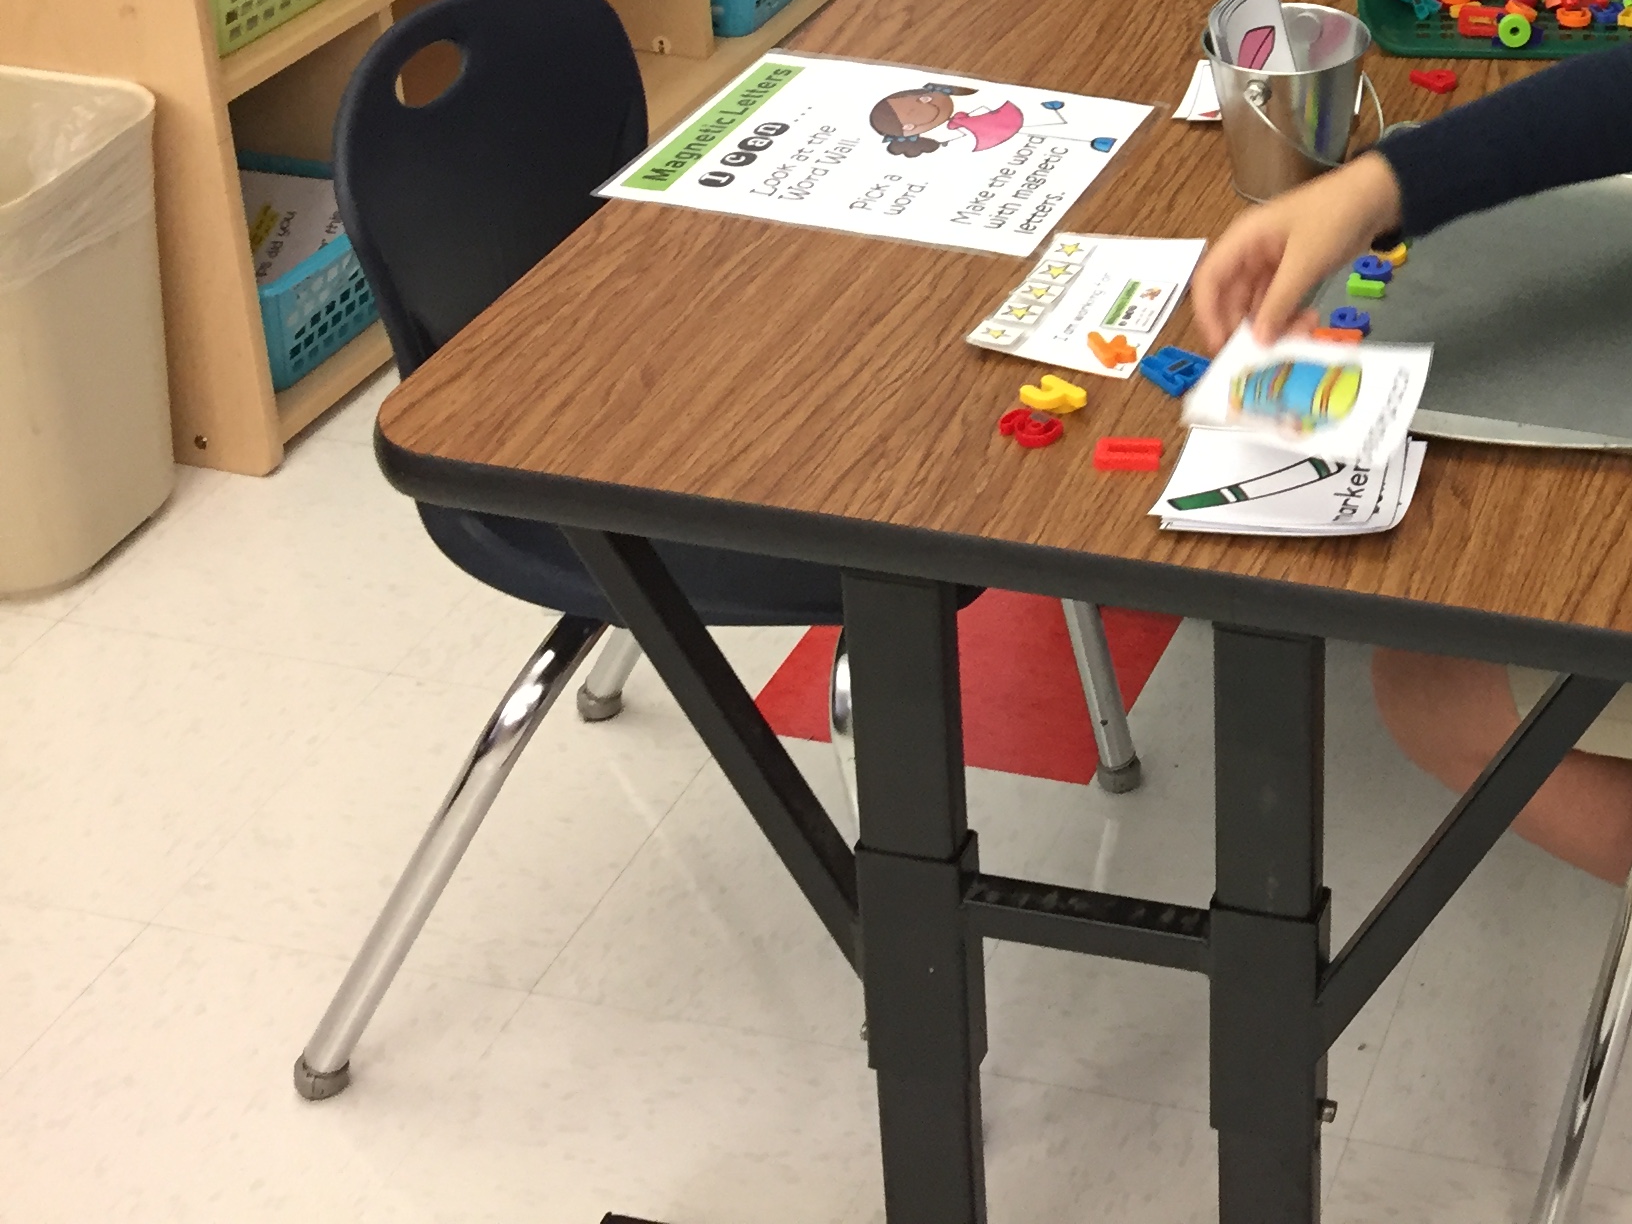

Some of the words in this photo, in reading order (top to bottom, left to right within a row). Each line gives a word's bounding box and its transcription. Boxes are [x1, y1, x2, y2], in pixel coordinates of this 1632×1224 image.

[641, 115, 736, 182] Magnetic
[719, 67, 793, 116] Letters
[750, 162, 797, 197] Look
[790, 147, 814, 163] at
[806, 124, 837, 146] the
[777, 165, 830, 201] Word
[848, 182, 891, 211] Pick
[883, 173, 903, 183] a
[950, 189, 996, 225] Make
[988, 165, 1017, 190] the
[1007, 133, 1047, 167] word
[983, 201, 1016, 230] with
[1011, 145, 1070, 202] magnetic
